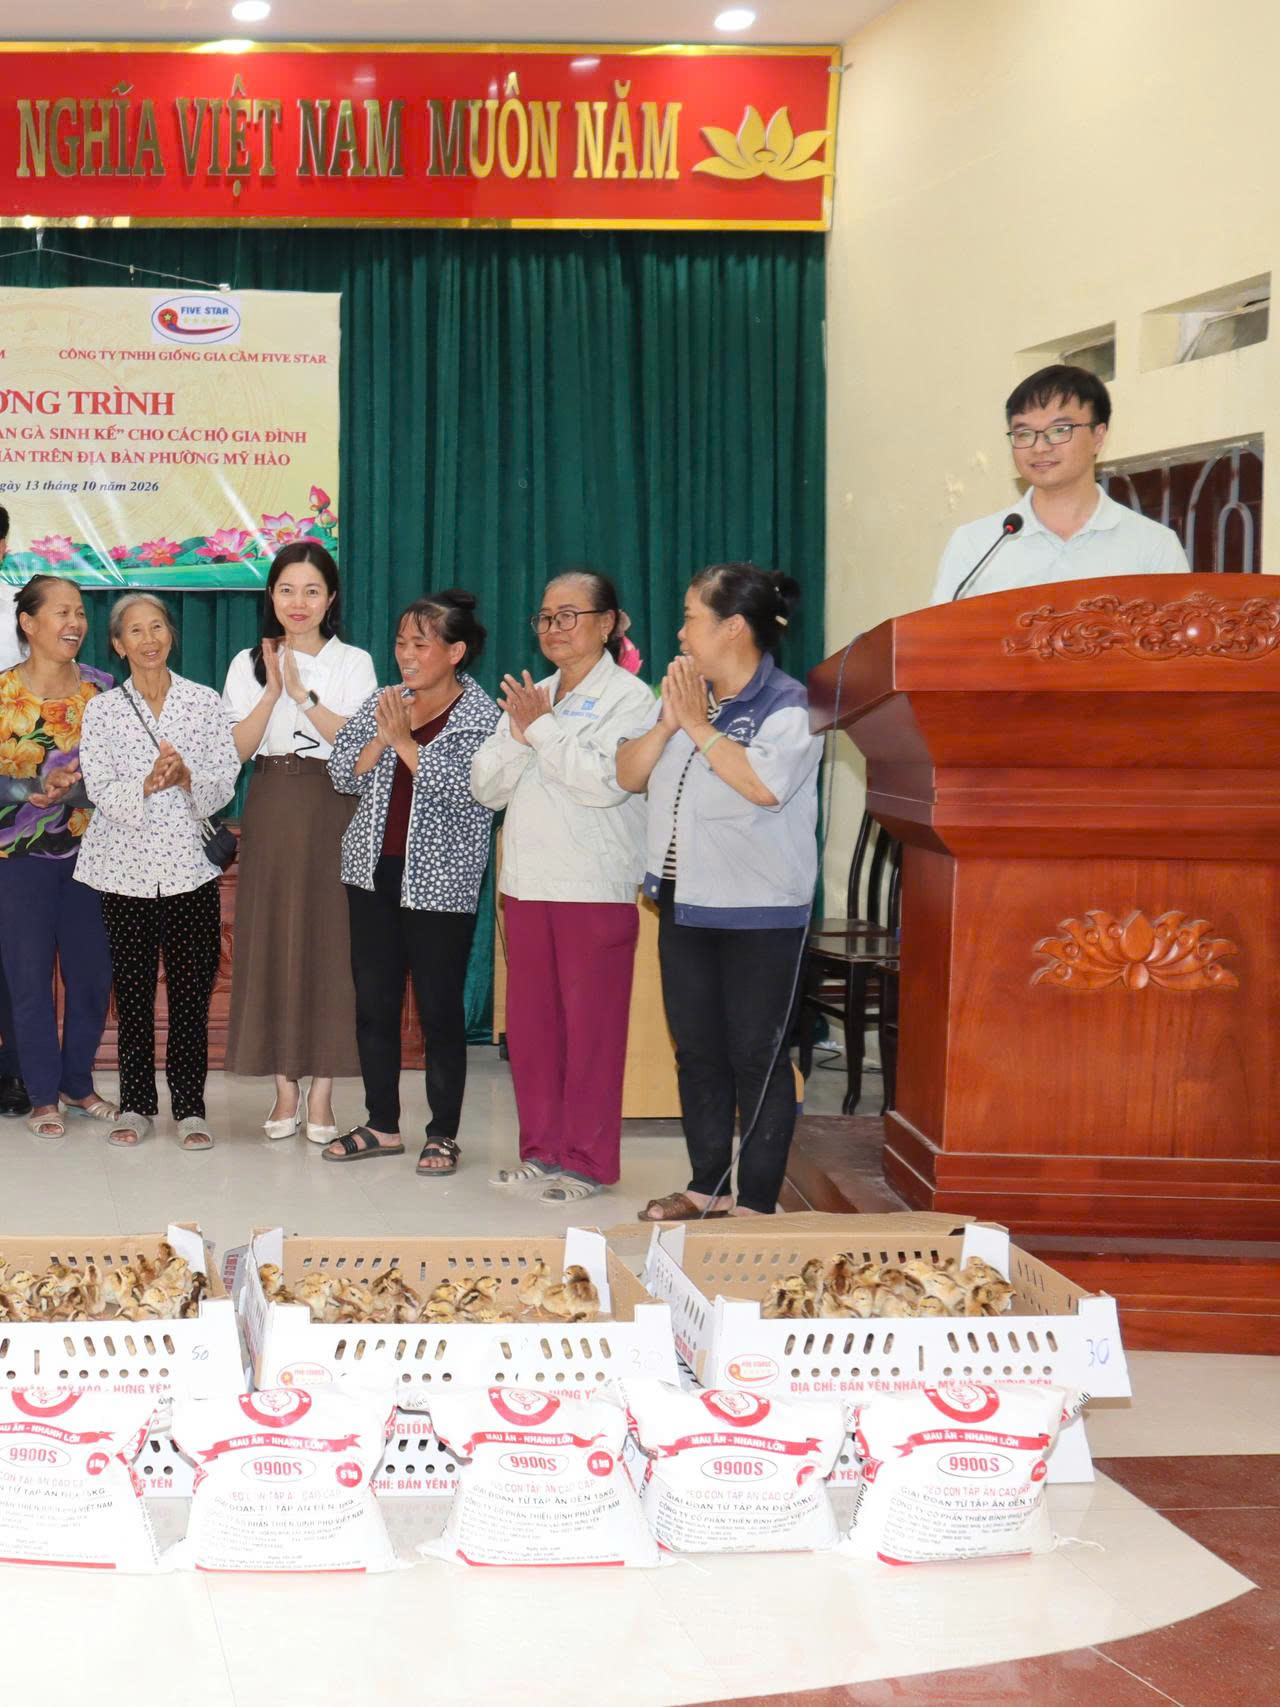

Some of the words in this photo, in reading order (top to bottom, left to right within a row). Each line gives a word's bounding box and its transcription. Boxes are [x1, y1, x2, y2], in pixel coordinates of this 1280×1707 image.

[16, 81, 165, 178] NGHĨA
[176, 73, 282, 198] VIỆT
[297, 97, 404, 178] NAM
[426, 71, 560, 181] MUÔN
[575, 78, 682, 181] NĂM
[181, 306, 201, 315] FIVE
[205, 306, 229, 315] STAR
[59, 349, 97, 361] CÔNG
[99, 351, 119, 361] TY
[120, 350, 156, 361] TNHH
[159, 349, 201, 362] GIỐNG
[204, 352, 227, 362] GIA
[230, 350, 258, 363] CẦM
[262, 353, 291, 363] FIVE
[294, 354, 327, 364] STAR
[67, 385, 176, 416] TRÌNH
[21, 424, 45, 440] GÀ
[50, 428, 89, 440] SINH
[128, 428, 164, 441] CHO
[168, 426, 204, 442] CÁC
[205, 427, 228, 444] HỘ
[232, 430, 260, 443] GIA
[265, 428, 307, 443] ĐÌNH
[29, 447, 73, 463] TRÊN
[77, 451, 106, 466] ĐỊA
[111, 450, 144, 464] BÀN
[149, 449, 219, 465] PHƯỜNG
[223, 451, 249, 465] MỸ
[254, 450, 291, 466] HÀO
[25, 480, 39, 491] 13
[42, 480, 78, 493] tháng
[82, 481, 97, 491] 10
[99, 481, 126, 492] năm
[130, 481, 160, 492] 2026
[868, 1378, 890, 1392] YÊN
[396, 1419, 433, 1434] GIỐN
[9, 1447, 57, 1464] 9900S
[510, 1455, 558, 1472] 9900S
[253, 1460, 303, 1476] 9900S
[713, 1460, 764, 1476] 9900S
[949, 1456, 1000, 1473] 9900S
